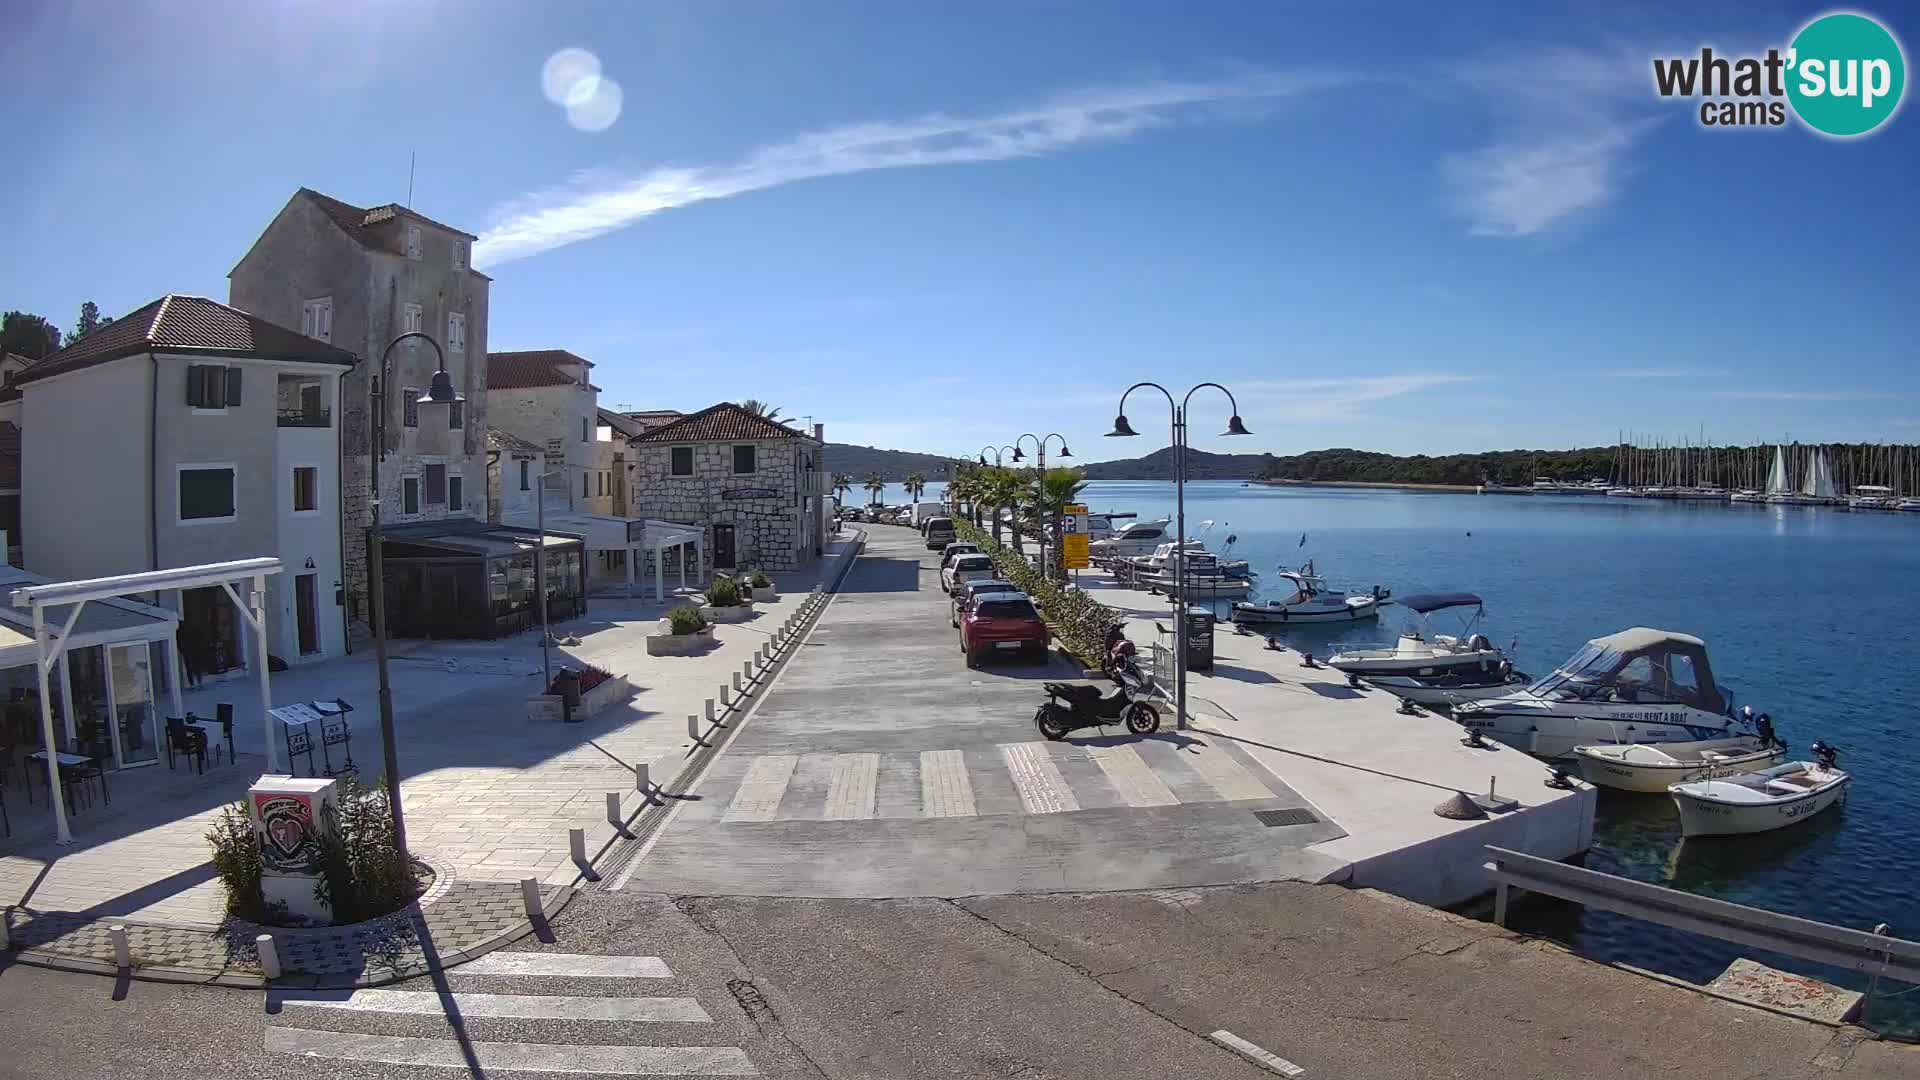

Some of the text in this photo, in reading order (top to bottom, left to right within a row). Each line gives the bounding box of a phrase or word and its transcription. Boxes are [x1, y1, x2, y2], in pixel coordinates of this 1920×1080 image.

[1644, 712, 1663, 721] RENT
[1664, 712, 1669, 722] A
[1670, 712, 1689, 724] BOAT
